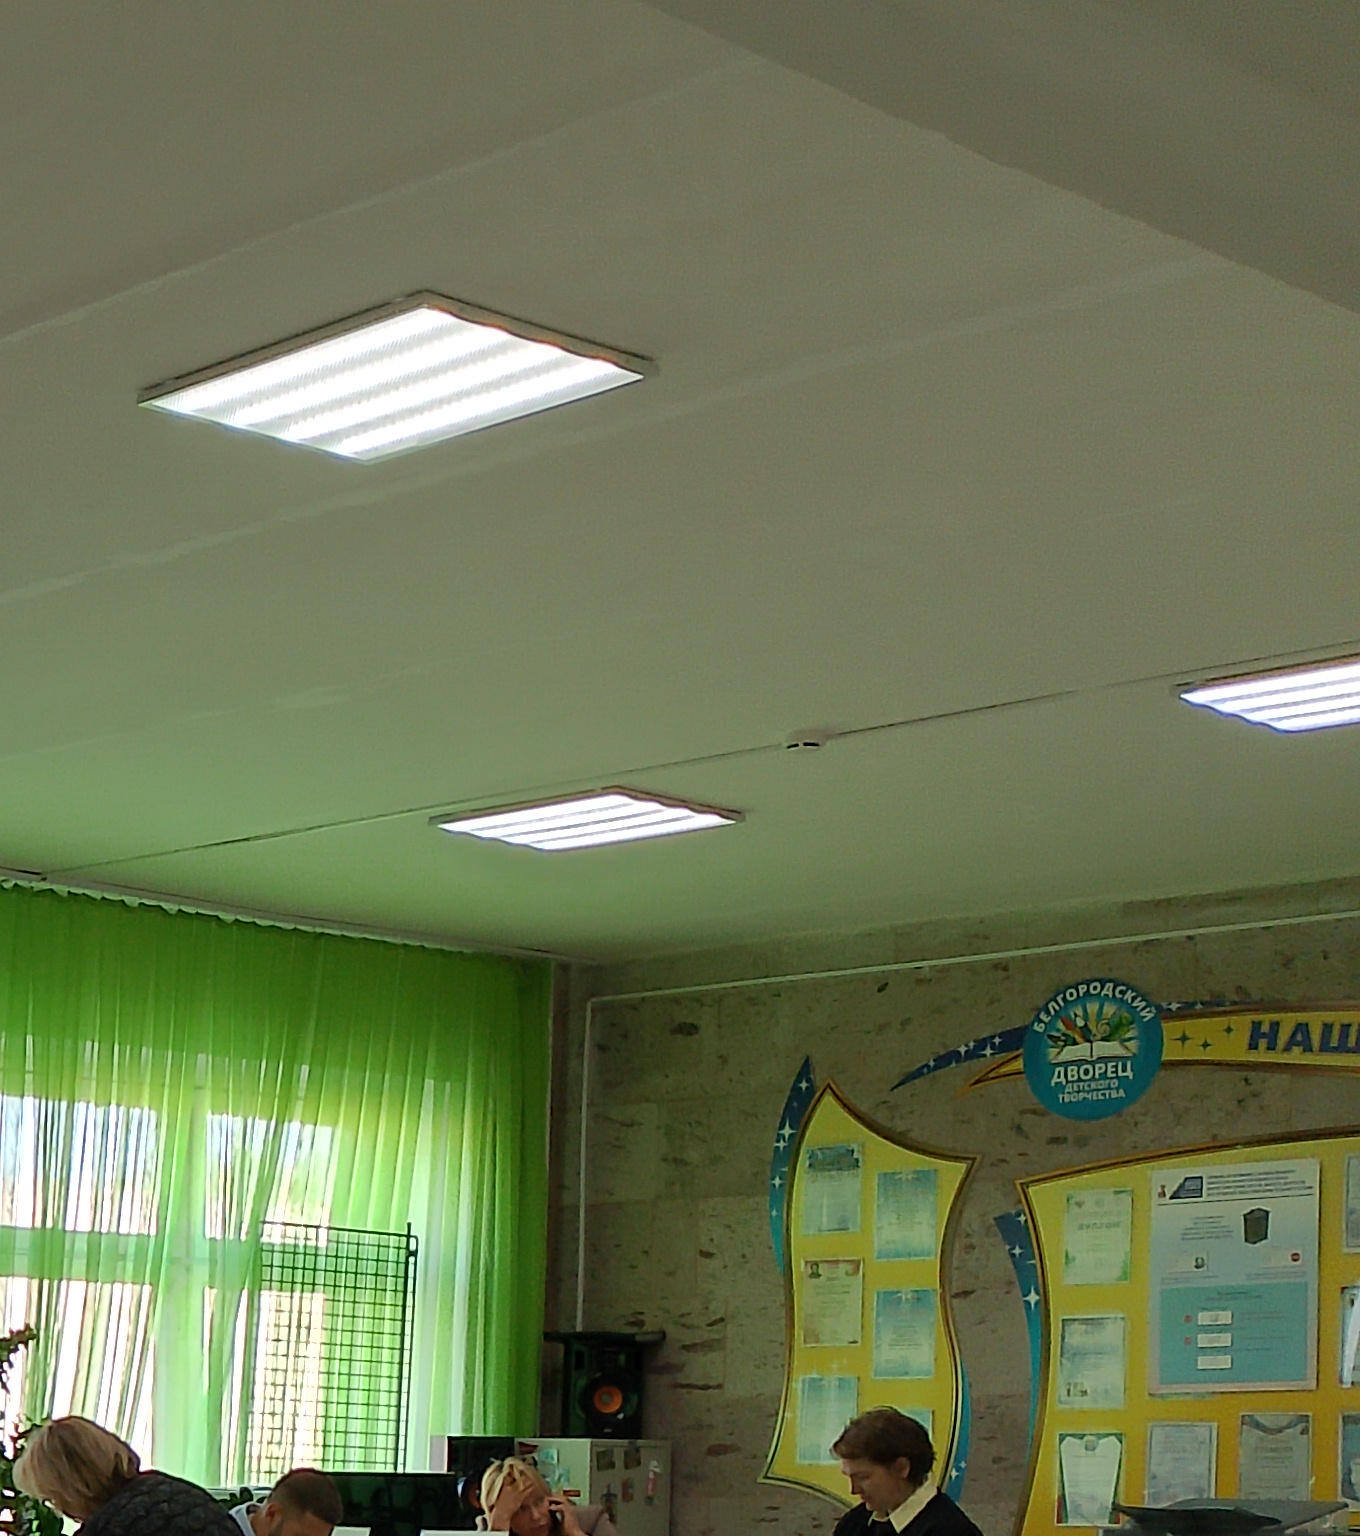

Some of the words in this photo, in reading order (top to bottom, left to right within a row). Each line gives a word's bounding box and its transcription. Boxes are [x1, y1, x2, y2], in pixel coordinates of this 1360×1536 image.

[1033, 981, 1156, 1033] БЕЛГОРОДСКИЙ
[1050, 1060, 1133, 1087] ДВОРЕЦ
[1058, 1088, 1126, 1103] ТВОРЧЕСТВА
[1064, 1079, 1118, 1093] ДЕТСКОГО
